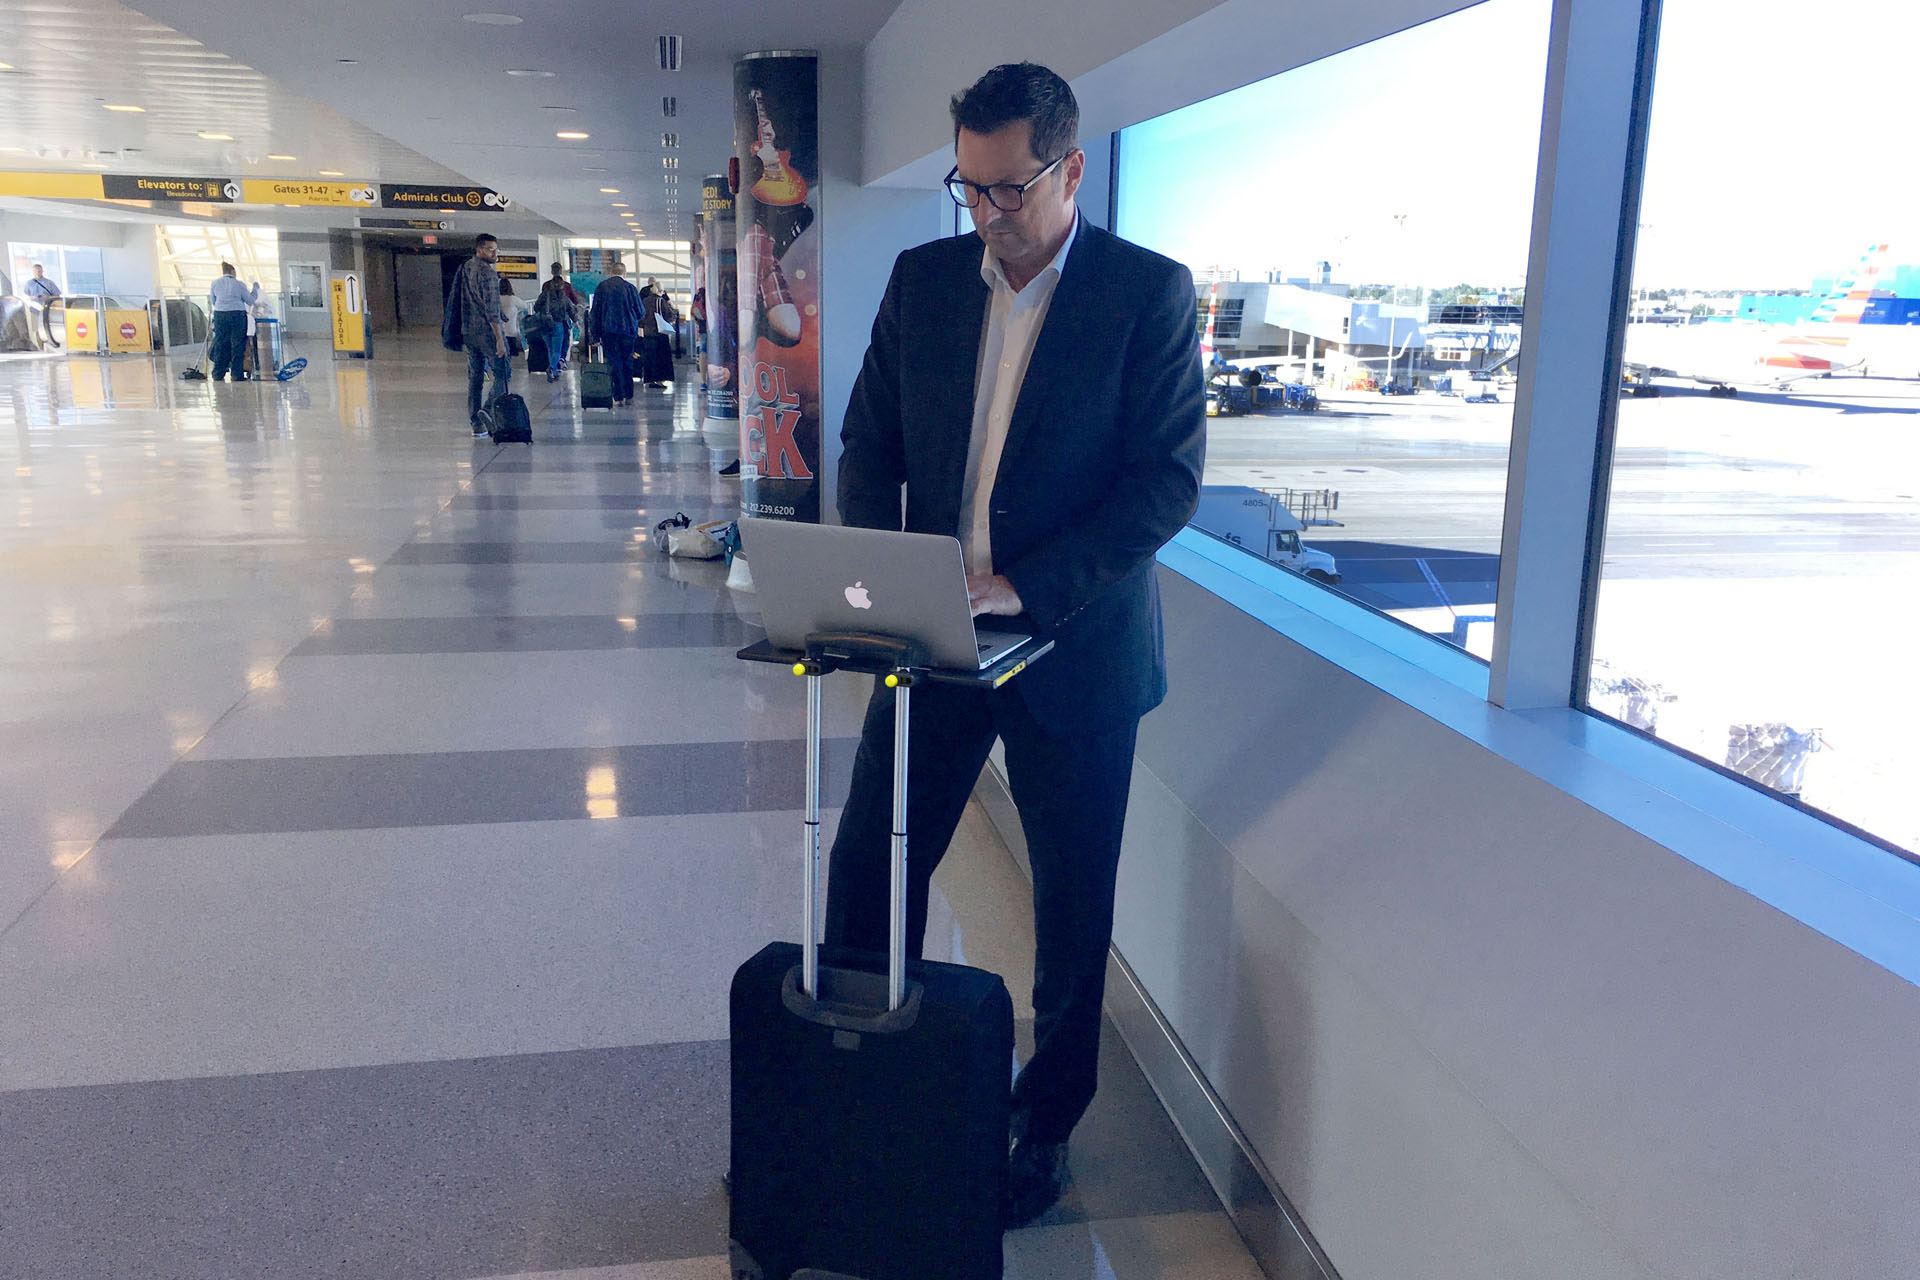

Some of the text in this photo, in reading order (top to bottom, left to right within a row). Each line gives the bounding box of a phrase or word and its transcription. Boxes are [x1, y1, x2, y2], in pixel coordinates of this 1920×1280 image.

[137, 179, 203, 191] Elevators to:
[273, 184, 328, 195] Gates 31-47
[393, 191, 464, 203] Admirals Club
[709, 199, 732, 209] STORY
[336, 294, 344, 345] ELEVATORS
[749, 502, 795, 516] 212.239.6200
[1242, 499, 1264, 507] 4805
